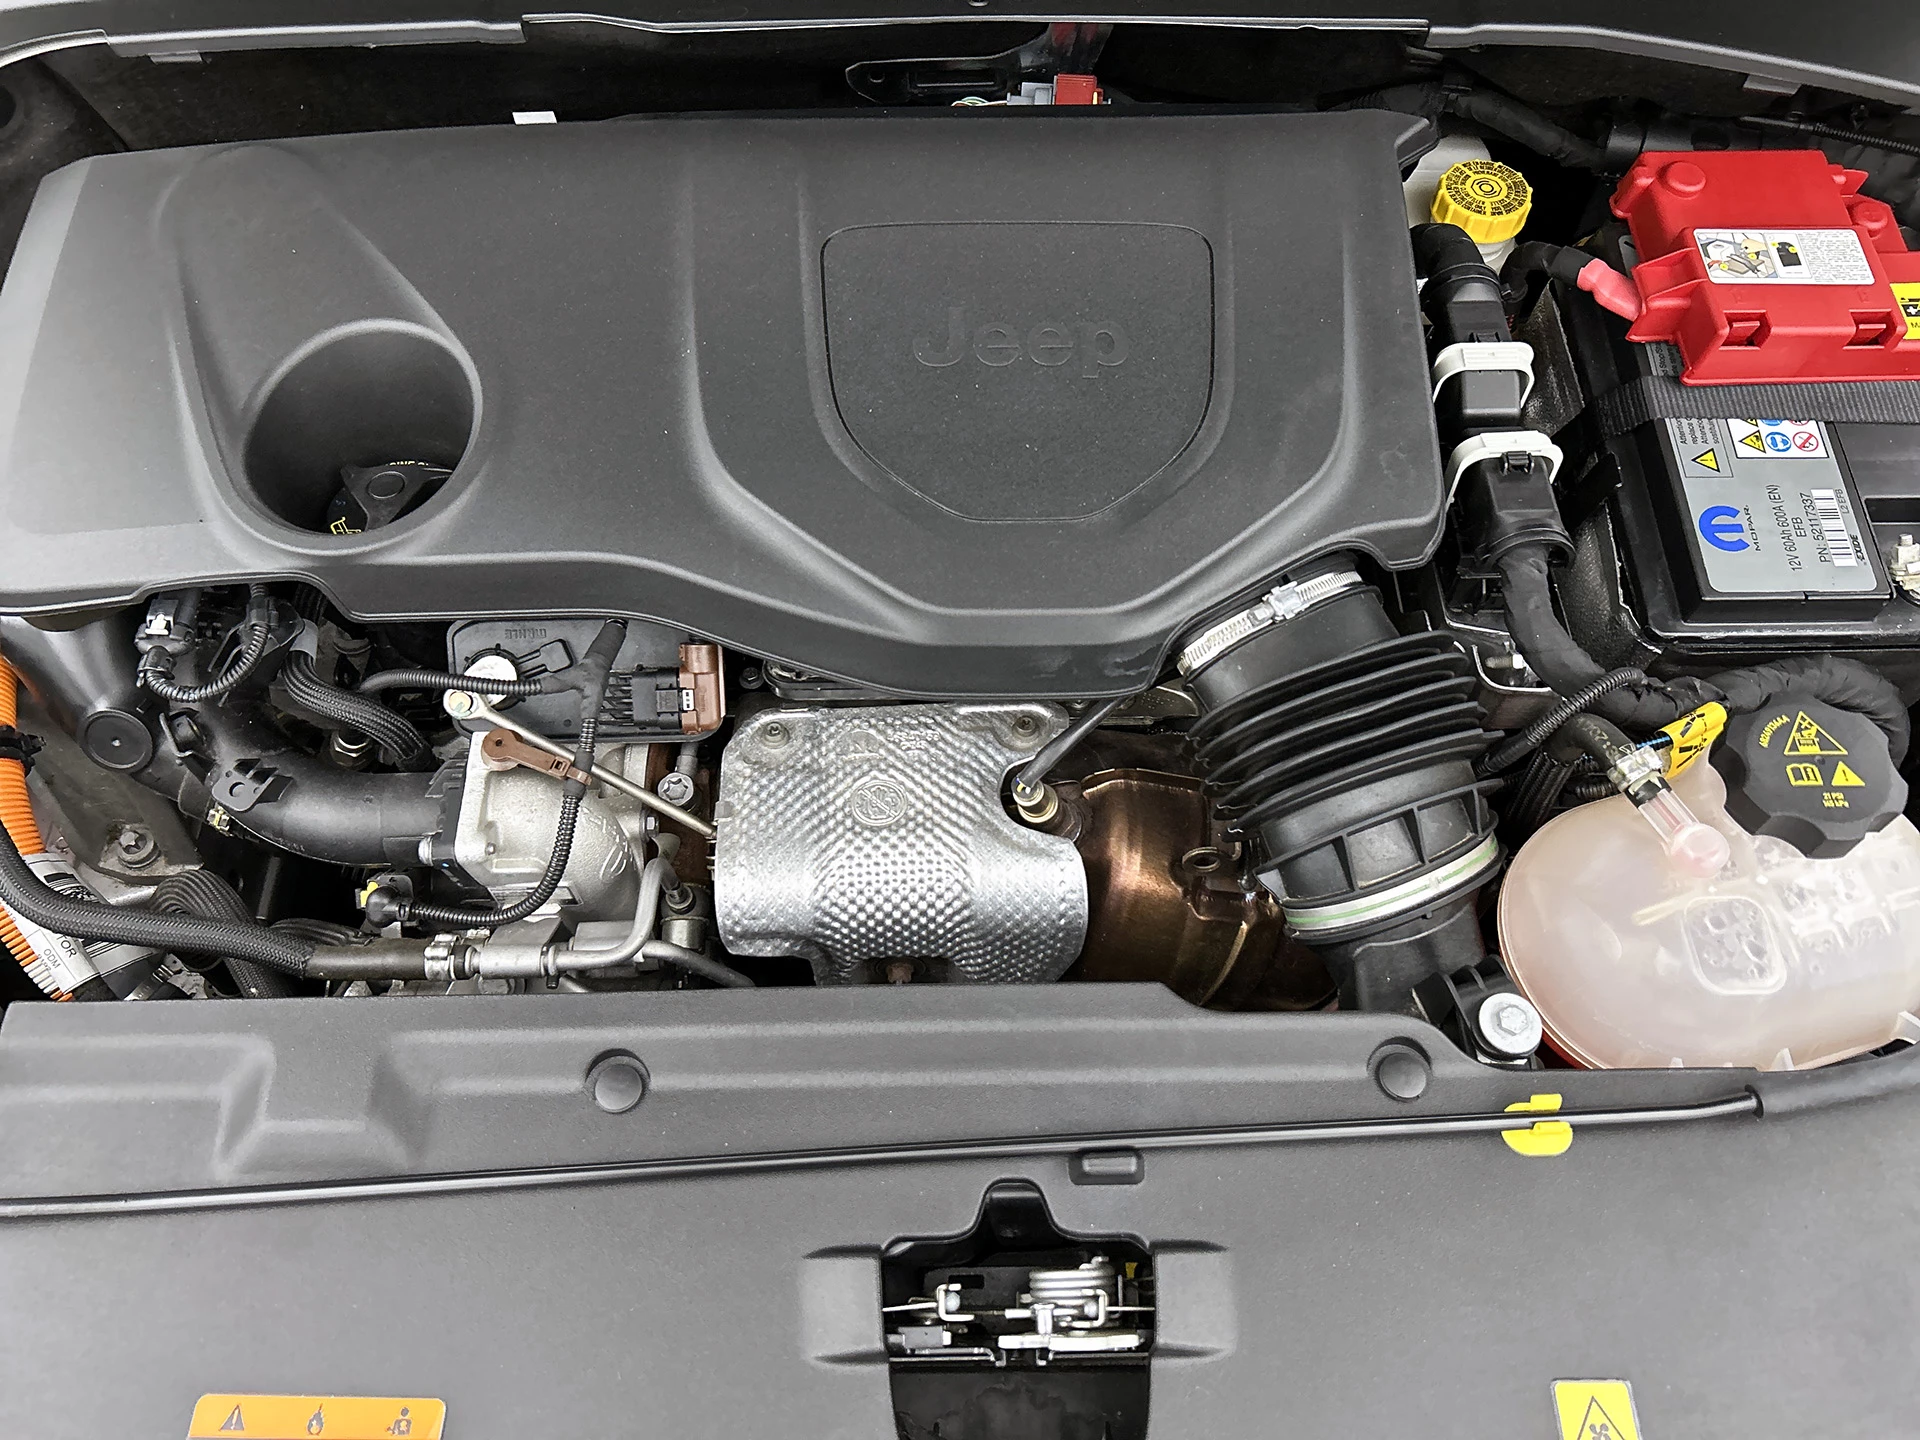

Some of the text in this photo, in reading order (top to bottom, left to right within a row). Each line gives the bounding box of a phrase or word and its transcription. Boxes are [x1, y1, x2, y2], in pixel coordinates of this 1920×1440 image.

[913, 306, 1129, 379] Jeep
[1835, 488, 1847, 504] EFB
[1744, 507, 1761, 551] MOPAR
[1766, 484, 1802, 571] 12V 60Ah 600A (EN)
[1791, 517, 1807, 538] EFB
[1800, 492, 1825, 541] 52117337
[1850, 534, 1865, 561] EXIDE
[43, 948, 61, 969] ODM
